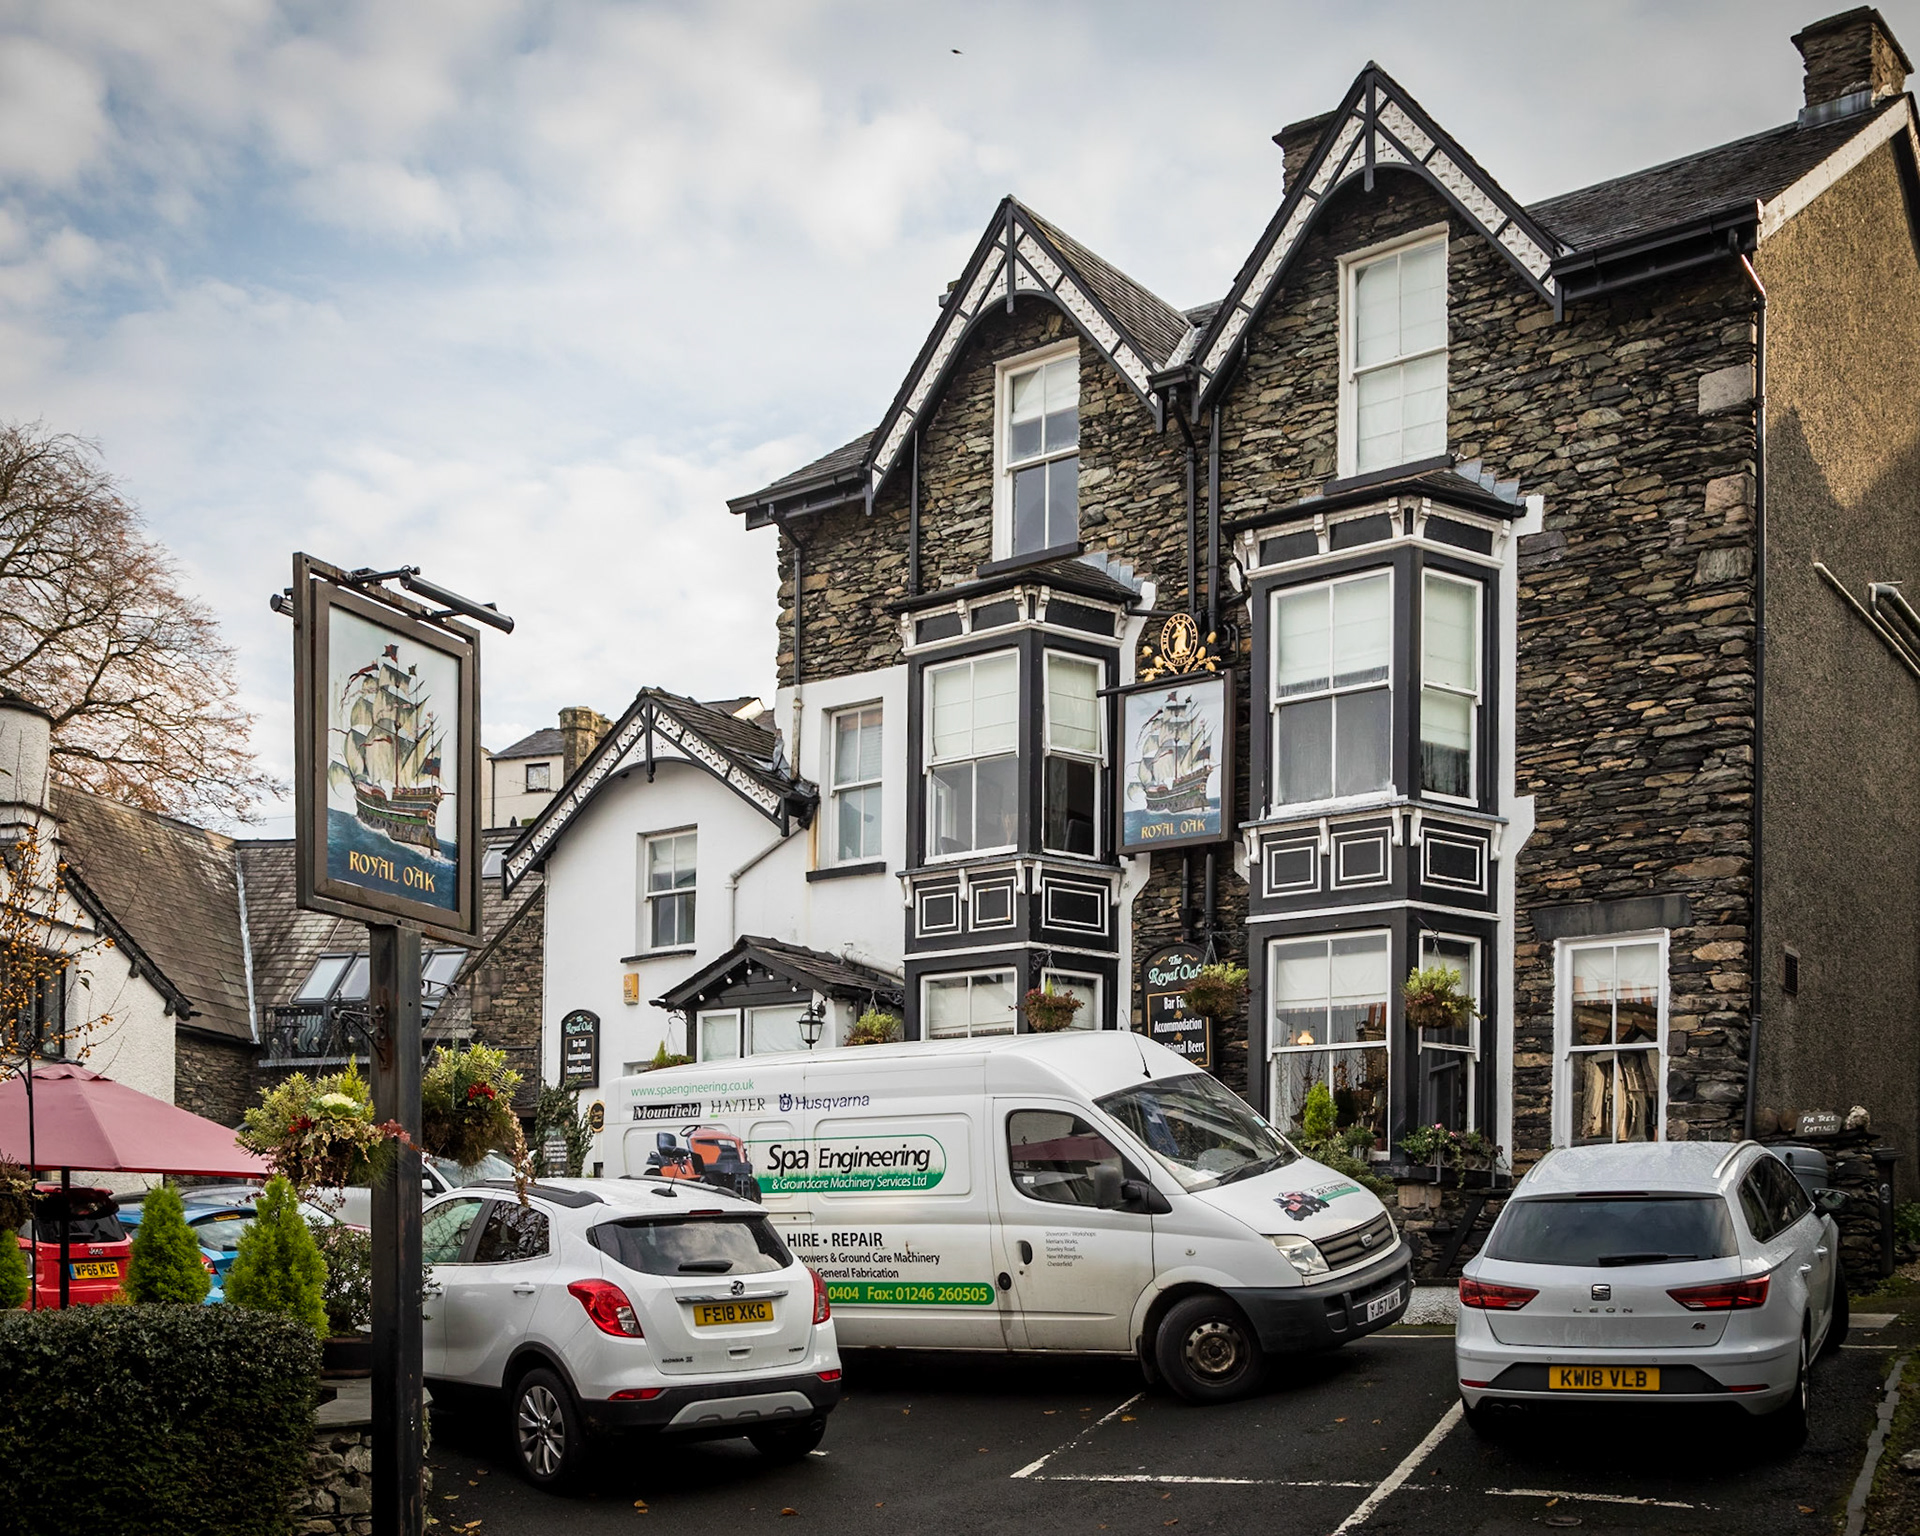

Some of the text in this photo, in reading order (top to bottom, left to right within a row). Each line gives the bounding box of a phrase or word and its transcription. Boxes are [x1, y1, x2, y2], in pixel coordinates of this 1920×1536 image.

[1141, 818, 1206, 839] ROYAL OAK
[349, 850, 436, 893] ROYAL OAK
[1168, 954, 1182, 966] The
[1148, 965, 1179, 986] Royal
[1163, 995, 1187, 1010] Bar Fo
[1153, 1018, 1202, 1034] Accommodation
[1187, 1040, 1205, 1054] Beers
[631, 1079, 755, 1097] www.spaengineering.co.uk
[634, 1102, 700, 1120] Mountfield
[711, 1097, 766, 1113] HAYTER
[795, 1094, 870, 1112] Husqvarna
[1817, 1114, 1835, 1122] TREE
[767, 1143, 931, 1177] Spa Engineering
[772, 1175, 928, 1190] & Groundcare Machinery Services Ltd
[787, 1232, 884, 1247] HIRE REPAIR
[798, 1252, 940, 1265] mowers & Ground Care Machinery
[816, 1267, 899, 1279] General Fabrication
[828, 1286, 988, 1302] 0404 Fax: 01246 260505
[703, 1303, 766, 1323] FE18 XKG
[1560, 1369, 1648, 1388] KW18 VLB
